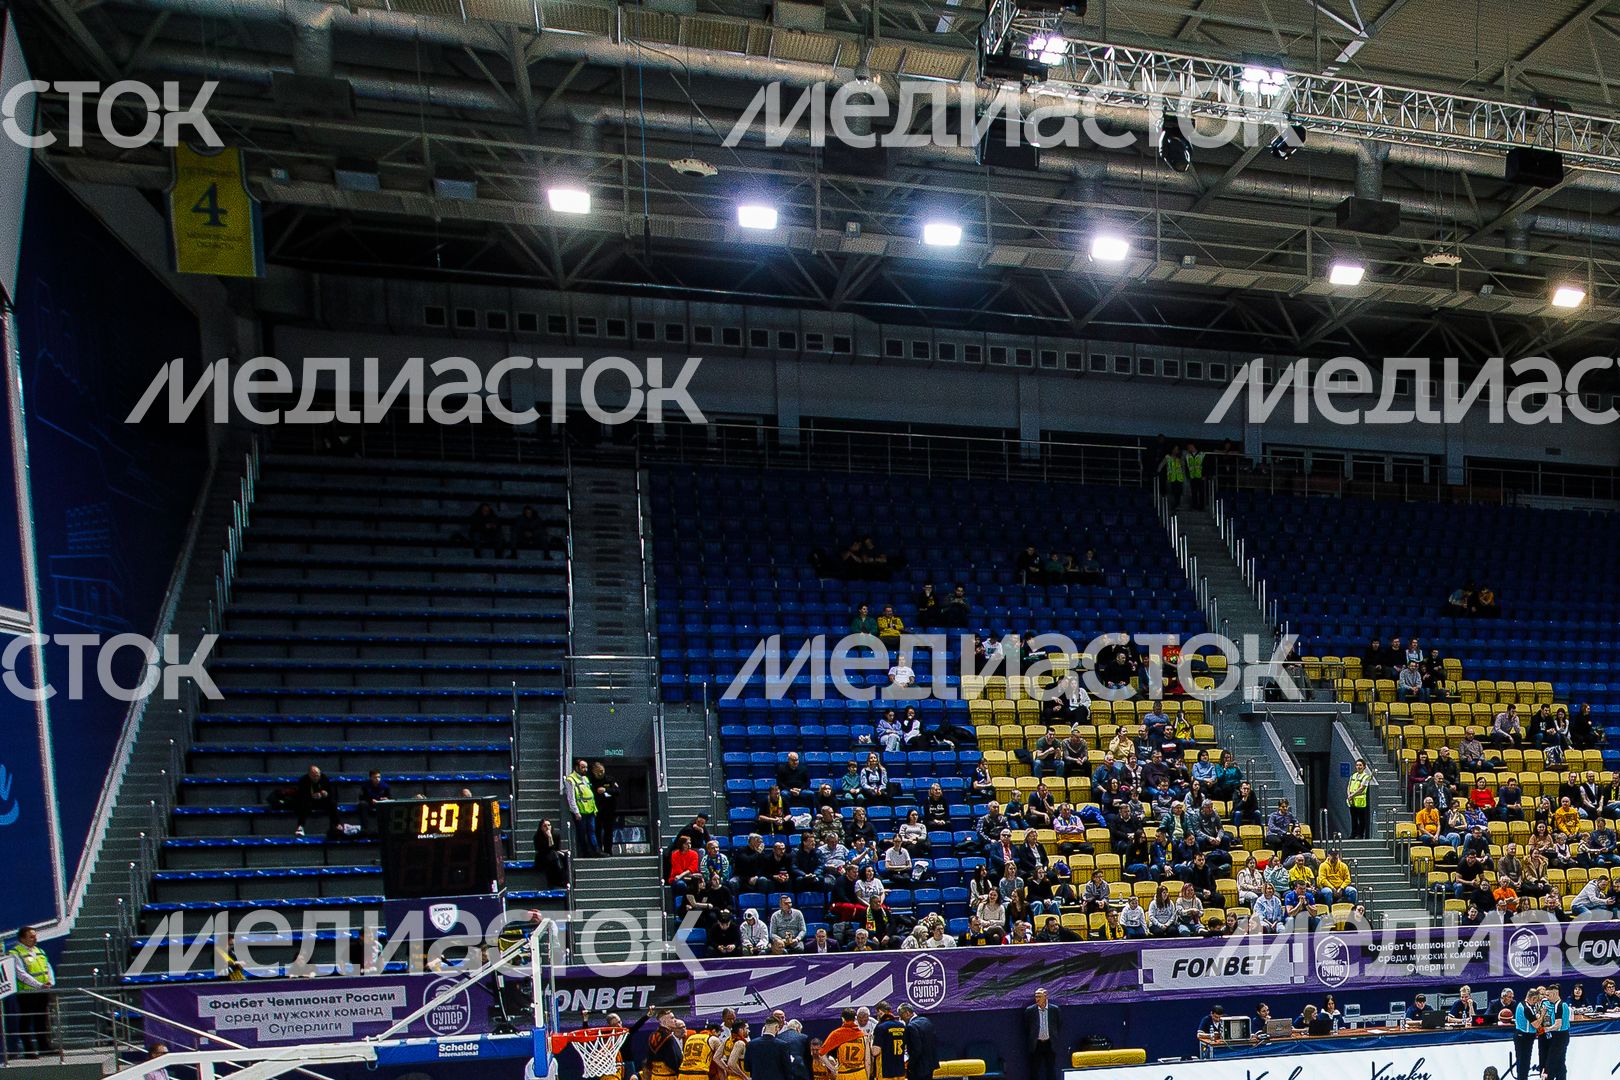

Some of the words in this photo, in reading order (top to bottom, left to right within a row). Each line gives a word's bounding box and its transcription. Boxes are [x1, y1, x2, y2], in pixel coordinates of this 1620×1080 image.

[191, 182, 228, 227] 4
[420, 802, 480, 833] 1:01
[1368, 942, 1404, 952] Фонбет
[1405, 940, 1456, 950] Чемпионат
[1457, 938, 1491, 948] России
[1378, 954, 1408, 964] среди
[1409, 952, 1448, 962] мужских
[1450, 950, 1484, 959] команд
[1171, 954, 1273, 979] FONBET
[1406, 962, 1456, 974] Суперлиги
[209, 997, 264, 1010] Фонбет
[266, 995, 343, 1008] Чемпионат
[345, 992, 396, 1003] России
[551, 985, 656, 1012] ONBET
[224, 1012, 269, 1025] среди
[273, 1009, 331, 1021] мужских
[334, 1006, 384, 1017] команд
[268, 1021, 342, 1036] Суперлиги
[438, 1042, 479, 1052] Schelde
[845, 1045, 861, 1061] 12
